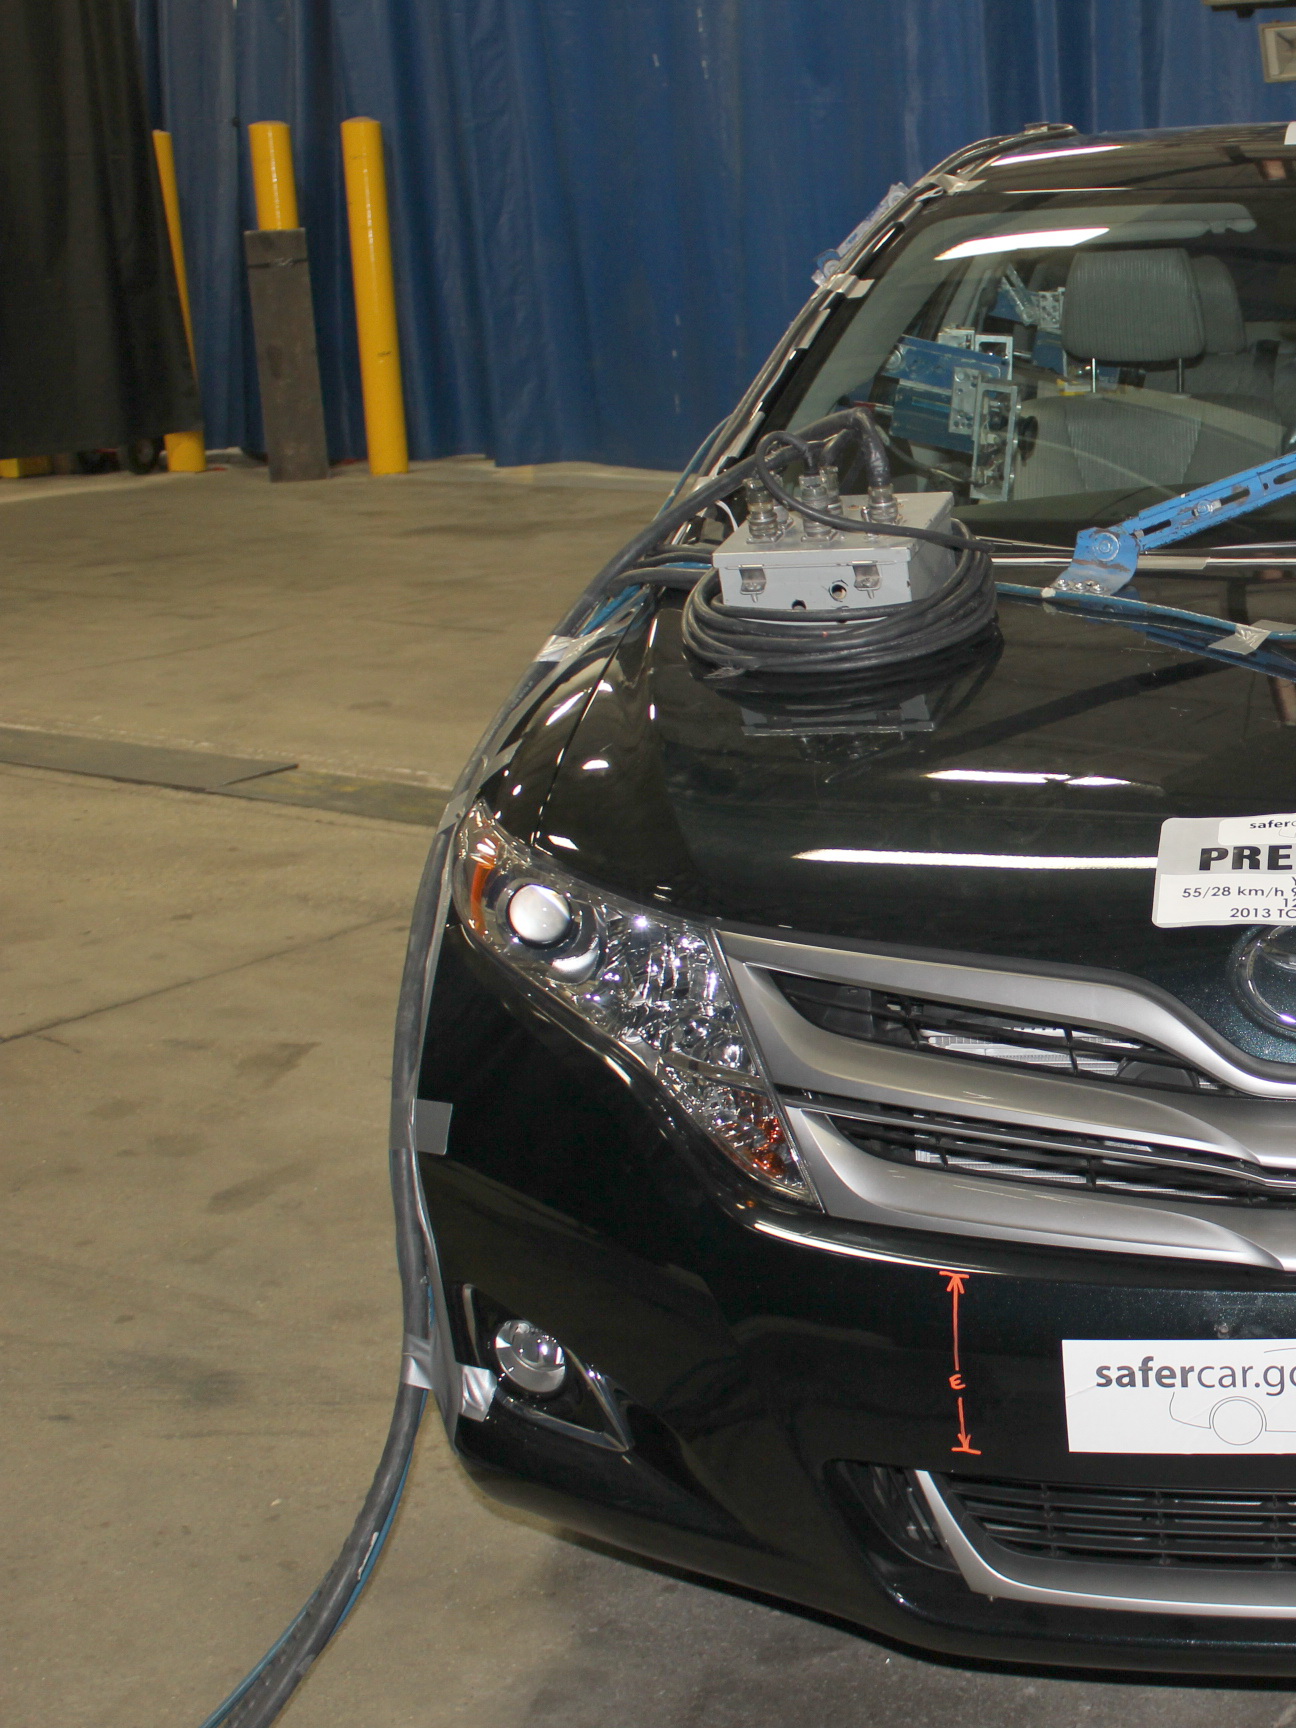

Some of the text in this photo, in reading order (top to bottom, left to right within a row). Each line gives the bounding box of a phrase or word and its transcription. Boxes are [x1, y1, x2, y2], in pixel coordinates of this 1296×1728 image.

[1181, 886, 1232, 899] 55/28
[1237, 886, 1285, 899] km/h
[1229, 907, 1272, 919] 2013
